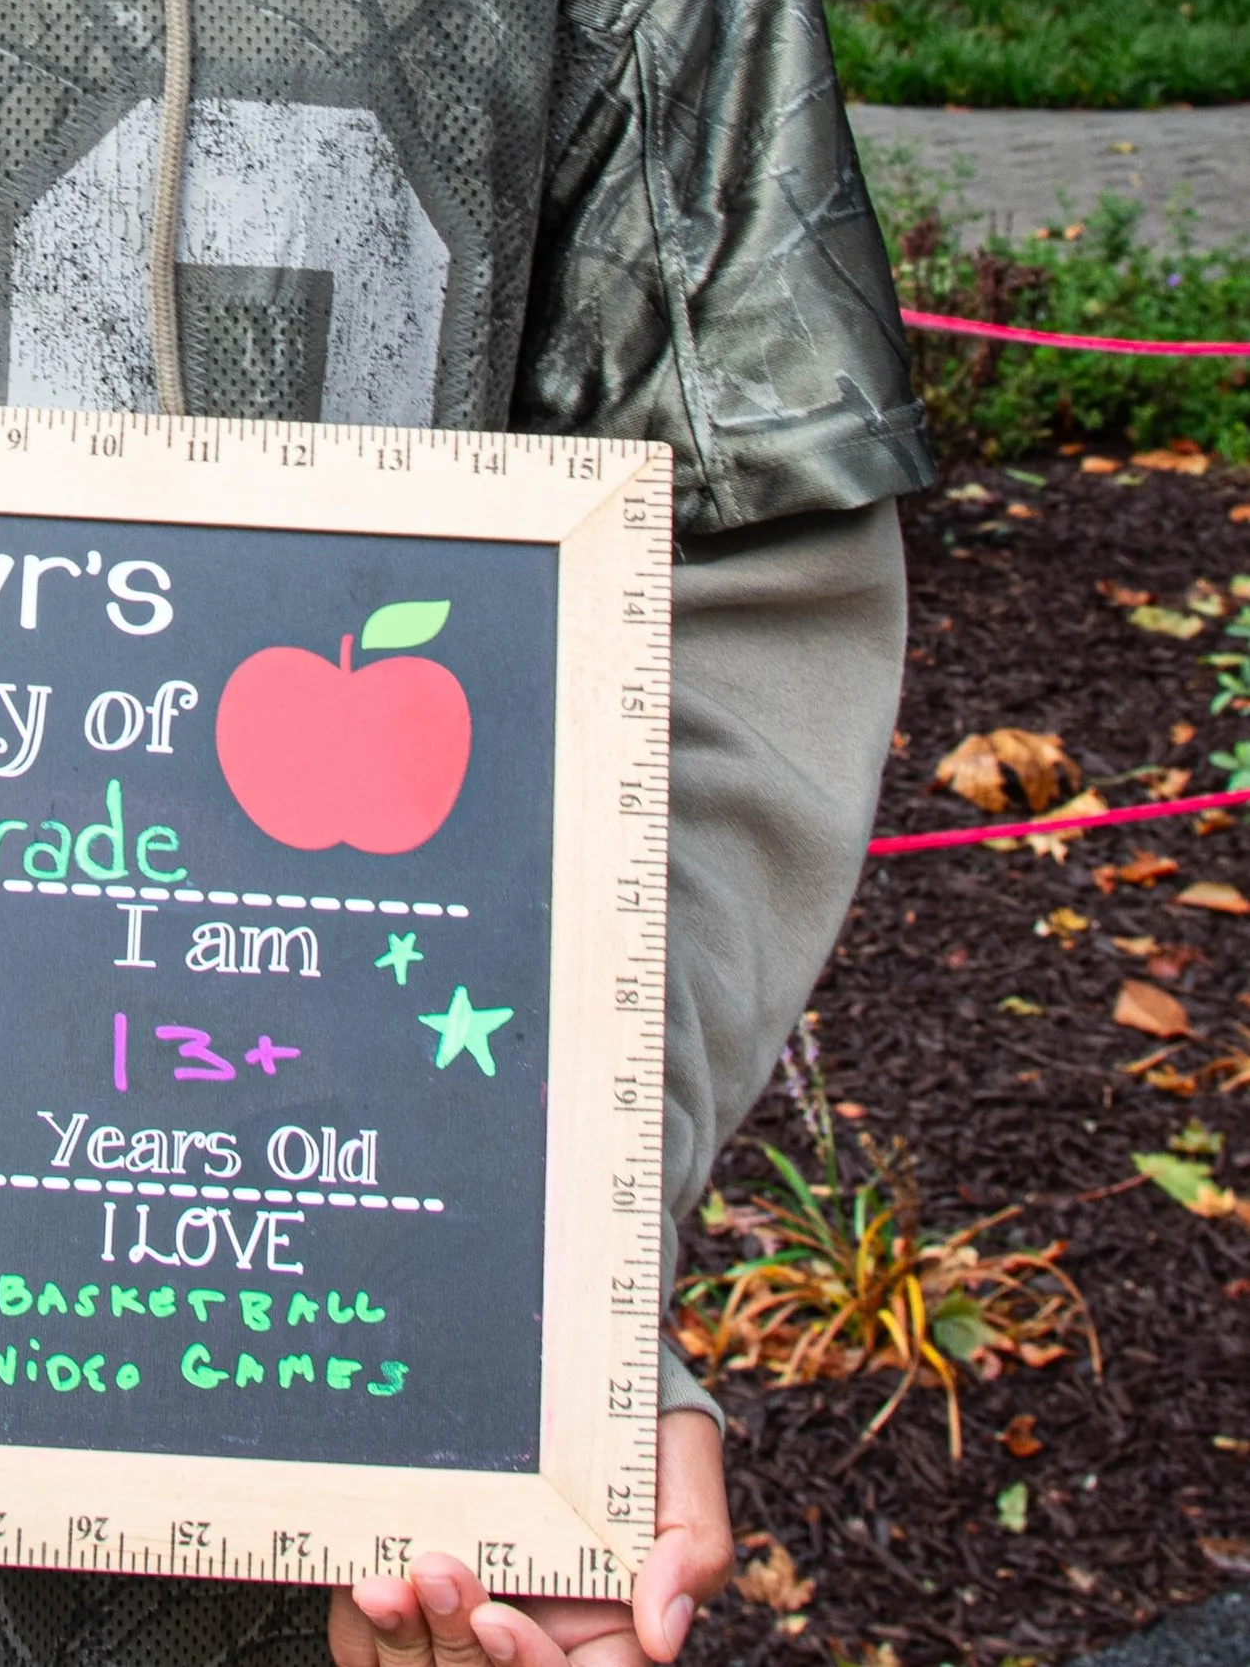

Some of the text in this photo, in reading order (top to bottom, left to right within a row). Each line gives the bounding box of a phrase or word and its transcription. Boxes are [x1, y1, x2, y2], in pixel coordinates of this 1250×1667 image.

[7, 429, 21, 450] 9
[90, 434, 117, 457] 10
[186, 437, 211, 462] 11
[280, 443, 307, 467] 12
[377, 448, 404, 471] 13
[472, 451, 499, 475] 14
[567, 456, 595, 480] 15
[85, 680, 198, 753] of
[114, 903, 321, 977] I am
[607, 496, 646, 1517] 13 14 15 16 17 18 19 20 21 22 23
[114, 1012, 302, 1092] 13+
[37, 1111, 378, 1186] Years Old
[101, 1201, 304, 1275] I LOVE
[180, 1342, 410, 1397] GAMES
[76, 1515, 109, 1541] 26
[178, 1520, 211, 1547] 25
[279, 1530, 312, 1557] 24
[381, 1536, 413, 1562] 23
[484, 1542, 516, 1567] 22
[588, 1547, 617, 1573] 21
